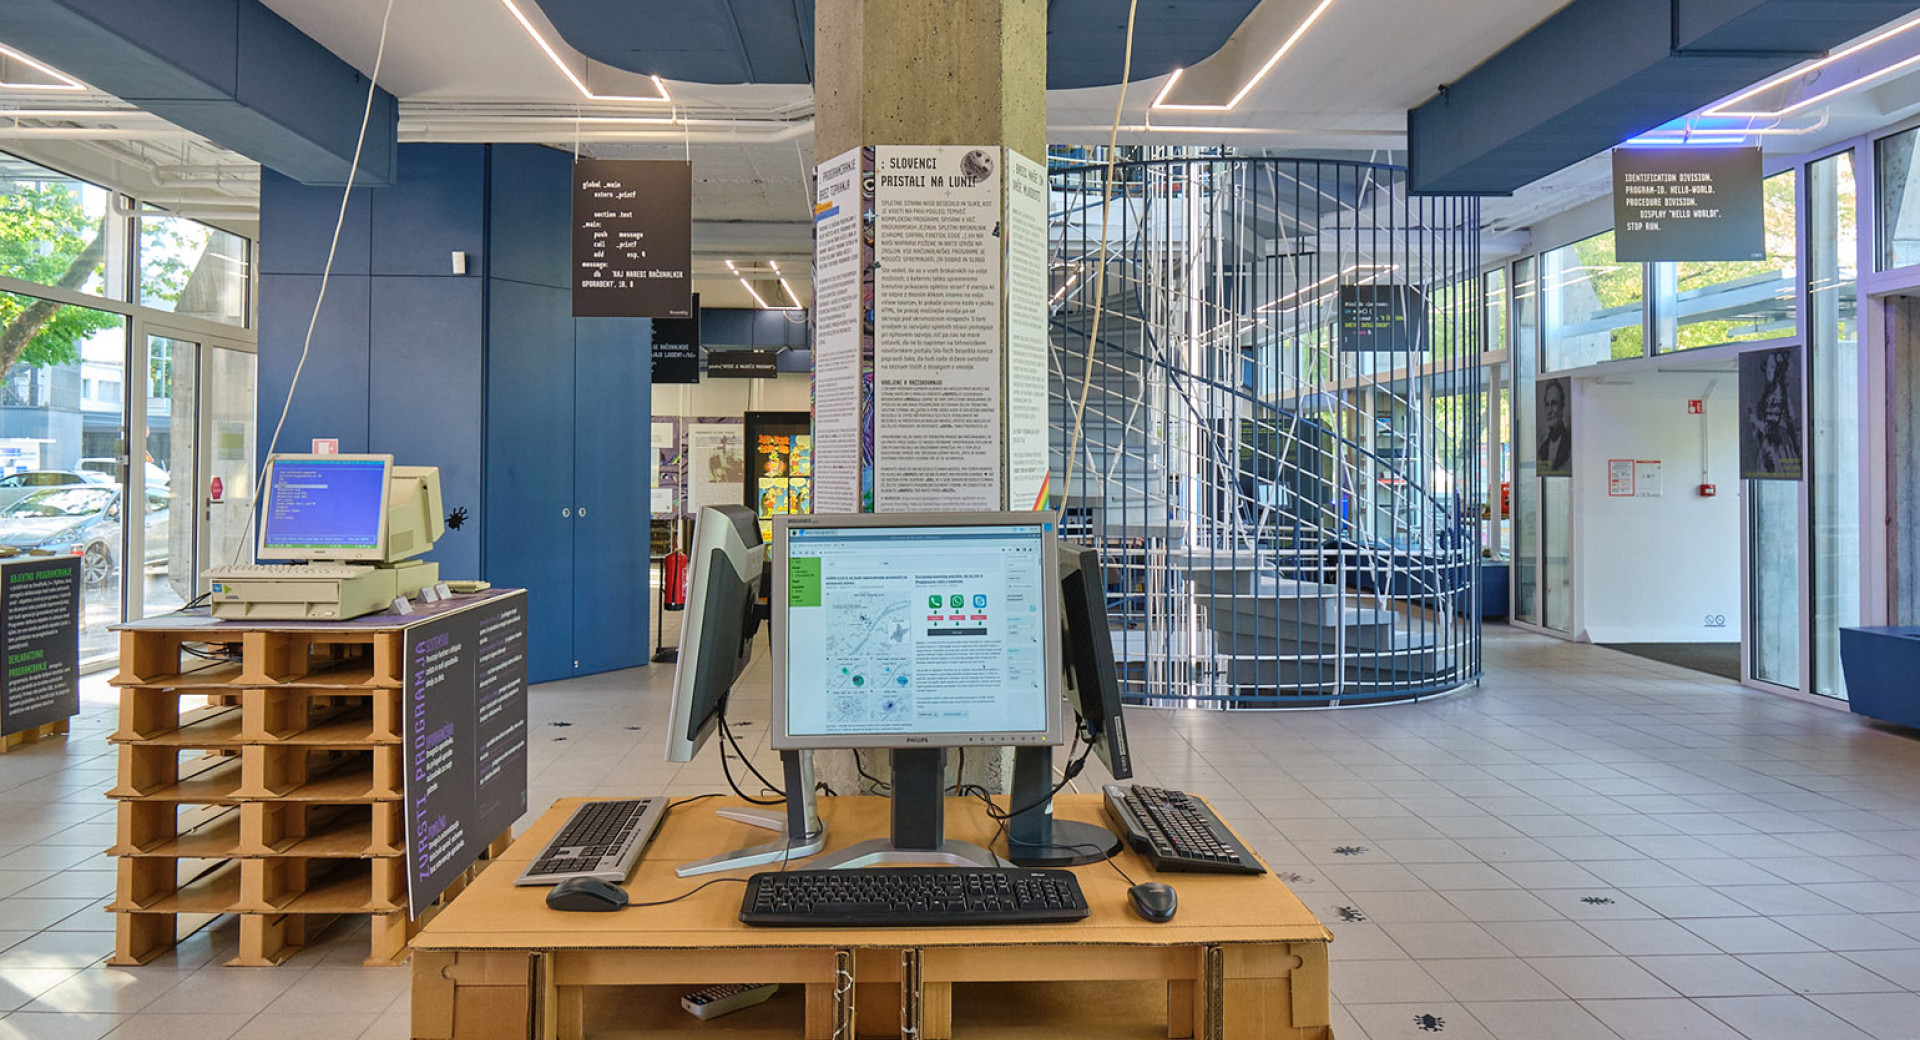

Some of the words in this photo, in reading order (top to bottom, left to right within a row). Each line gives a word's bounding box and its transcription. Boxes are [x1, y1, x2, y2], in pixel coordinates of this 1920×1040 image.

[890, 157, 937, 170] SLOVENCI
[881, 175, 926, 188] PRISTALI
[931, 175, 944, 188] NA
[949, 175, 976, 188] LUNI!
[1625, 173, 1676, 182] IDENTIFICATION
[1679, 173, 1713, 182] DIVISION.
[582, 181, 601, 190] global
[1625, 186, 1667, 195] PROGRAM-ID.
[1670, 185, 1715, 194] HELLO-WORLD.
[1626, 198, 1662, 207] PROCEDURE
[1664, 198, 1698, 206] DIVISION.
[1640, 210, 1667, 219] DISPLAY
[1626, 222, 1643, 231] STOP
[1645, 222, 1661, 231] RUN.
[593, 231, 608, 240] push
[619, 232, 644, 241] message
[581, 262, 609, 270] message:
[648, 269, 683, 278] RAČUNALNIK
[414, 640, 427, 783] PROGRAMJA
[416, 793, 431, 883] ZVRSTI
